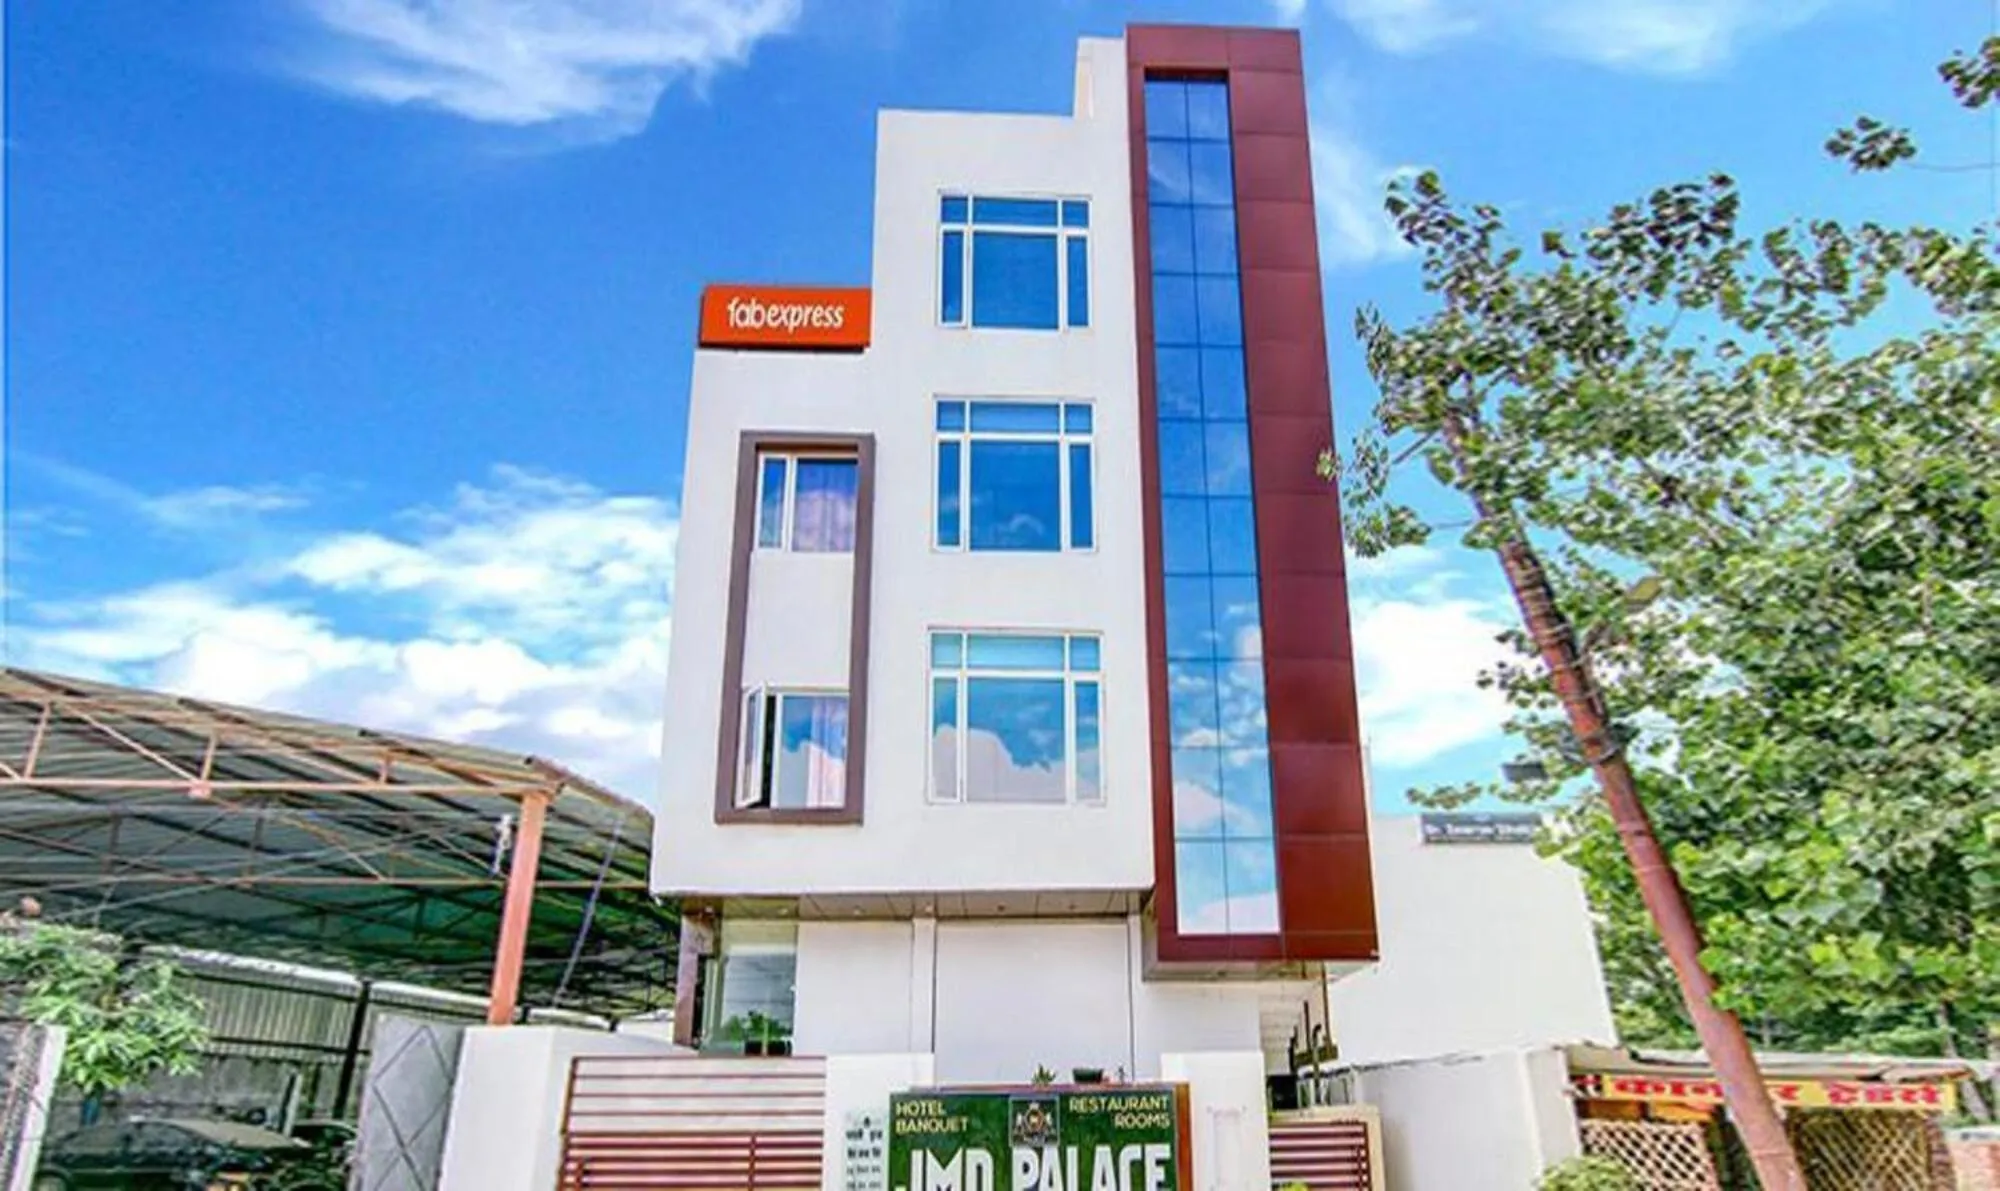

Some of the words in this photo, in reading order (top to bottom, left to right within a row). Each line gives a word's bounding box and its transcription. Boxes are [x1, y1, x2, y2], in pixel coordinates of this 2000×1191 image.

[727, 296, 844, 334] fabexpress
[895, 1100, 946, 1117] HOTEL
[1068, 1096, 1169, 1113] RESTAURANT
[895, 1117, 969, 1136] BANQUET
[1114, 1113, 1171, 1129] ROOMS
[1011, 1143, 1171, 1191] PALACE
